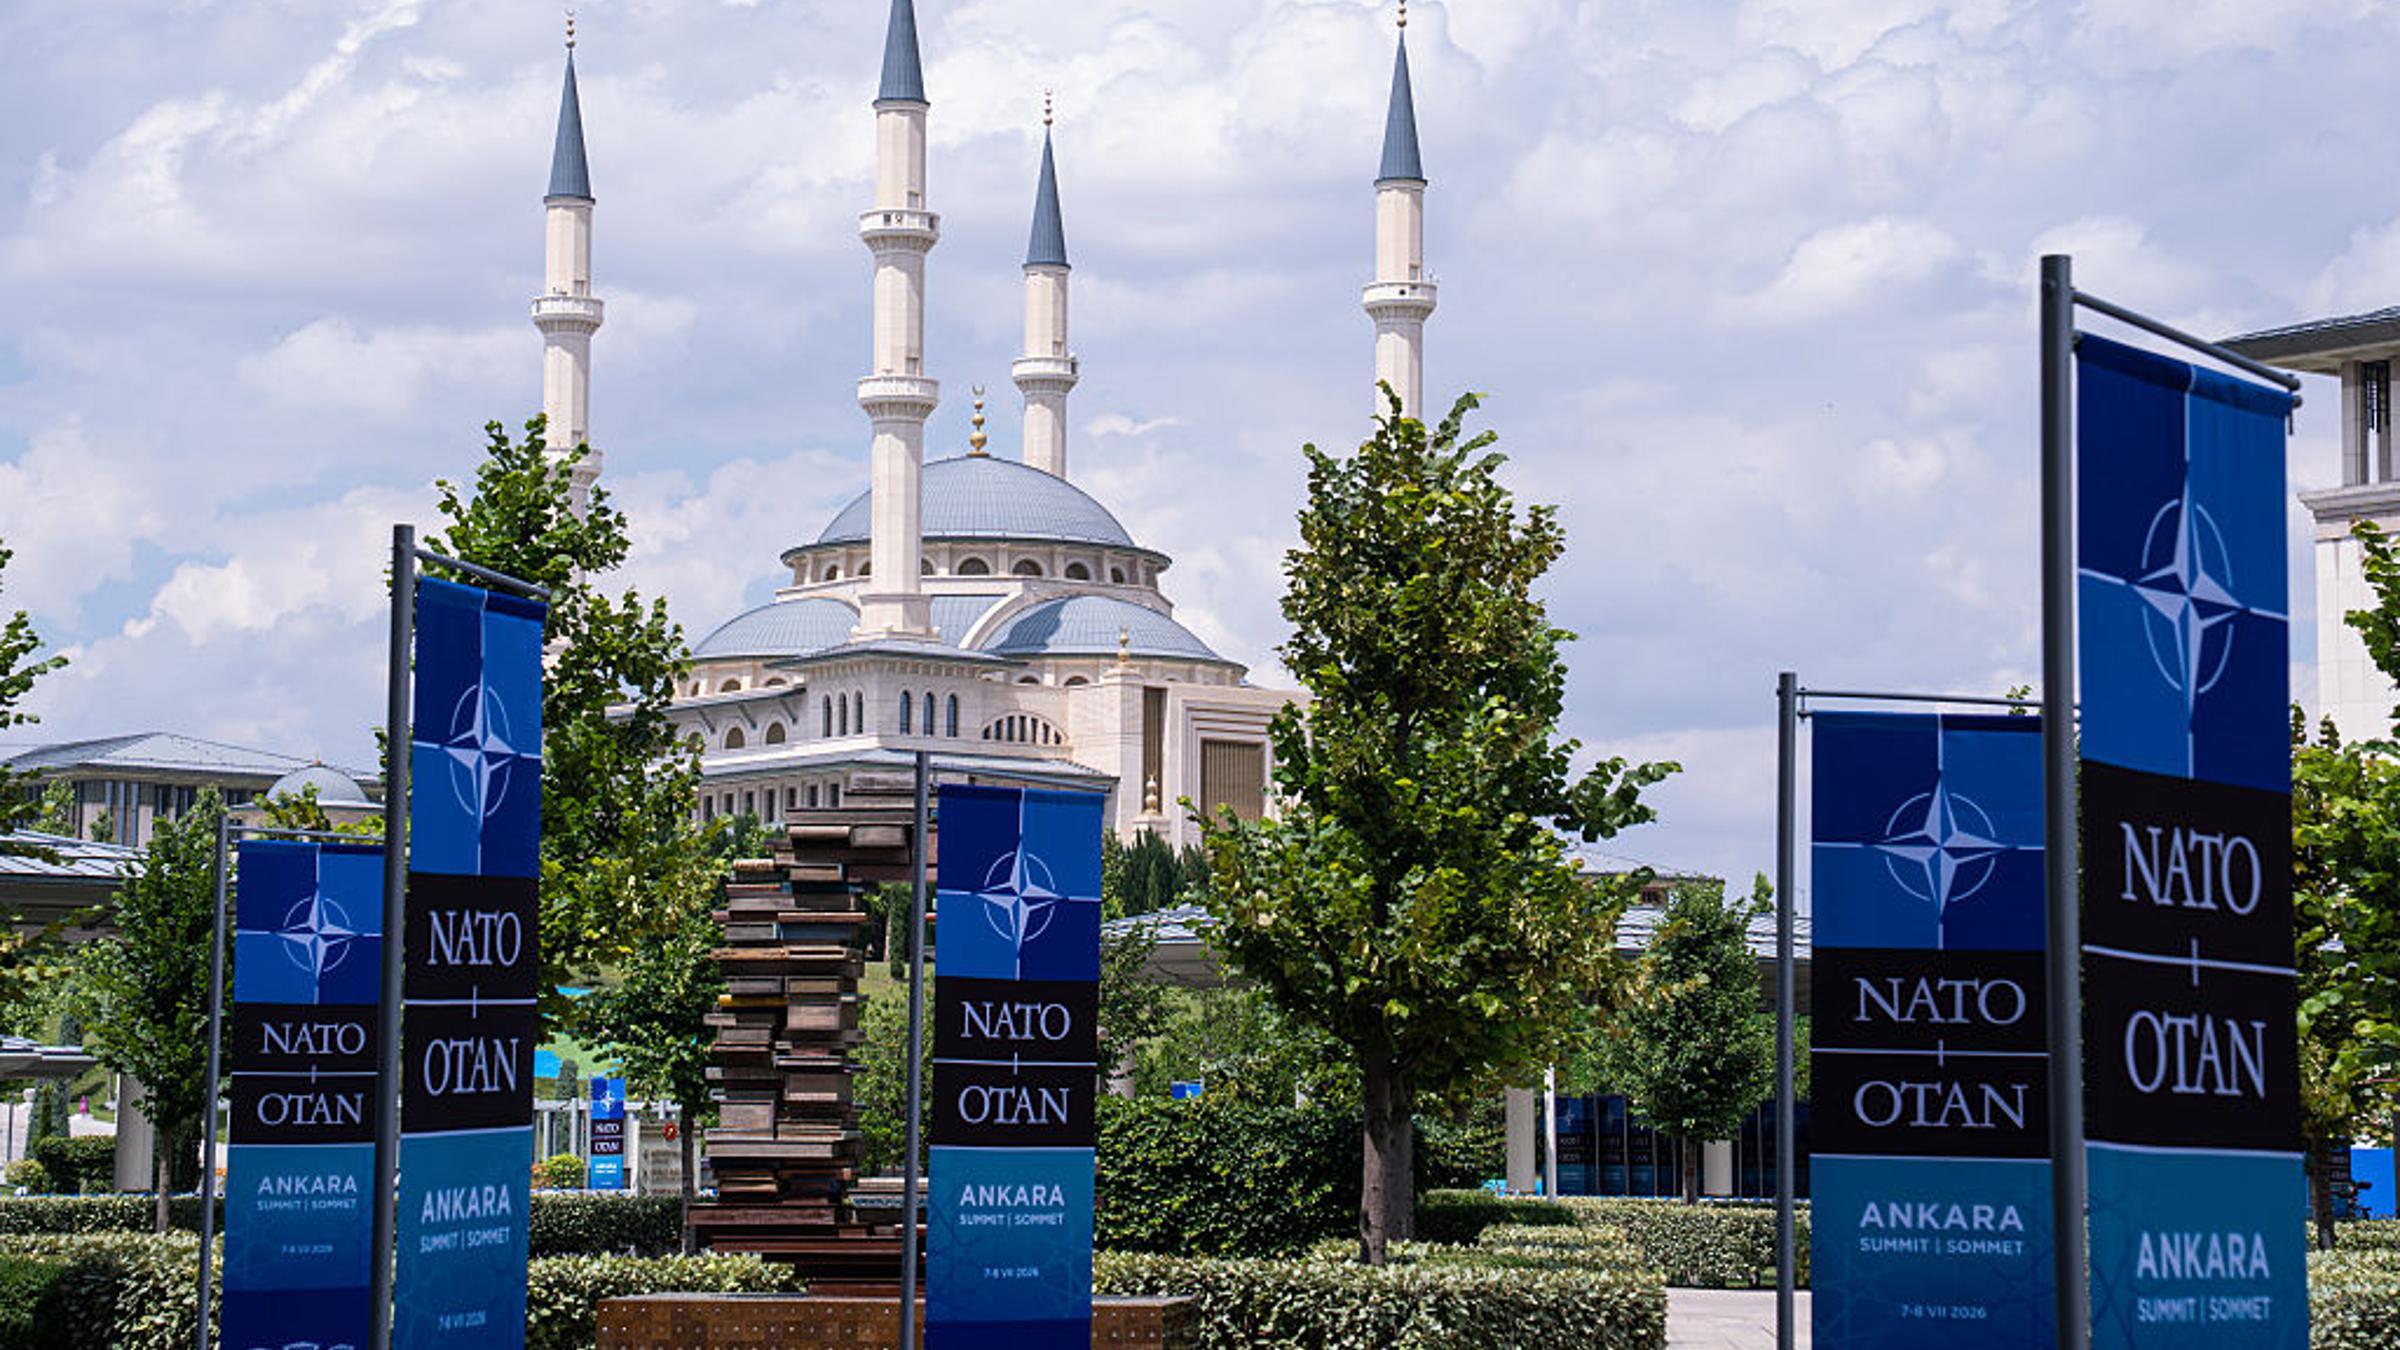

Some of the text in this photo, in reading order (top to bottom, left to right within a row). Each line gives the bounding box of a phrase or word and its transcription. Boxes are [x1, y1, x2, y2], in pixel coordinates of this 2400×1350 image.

[2120, 821, 2262, 916] NATO
[427, 909, 522, 967] NATO
[1853, 976, 2027, 1026] NATO
[260, 1022, 366, 1055] NATO
[960, 1001, 1071, 1041] NATO
[424, 1037, 520, 1097] OTAN
[2125, 1010, 2267, 1100] OTAN
[257, 1092, 364, 1126] OTAN
[958, 1085, 1070, 1125] OTAN
[1853, 1080, 2030, 1130] OTAN
[257, 1174, 358, 1195] ANKARA
[960, 1183, 1065, 1207] ANKARA
[420, 1183, 512, 1225] ANKARA
[960, 1212, 1065, 1226] SUMMIT SOMMET
[1859, 1201, 2024, 1232] ANKARA
[420, 1225, 511, 1254] SUMMIT SOMMET
[1860, 1237, 2025, 1256] SUMMIT SOMMET
[2136, 1230, 2270, 1280] ANKARA
[1926, 1305, 1946, 1319] VII
[1950, 1305, 1987, 1320] 2026
[2137, 1296, 2271, 1323] SUMMIT SOMMET
